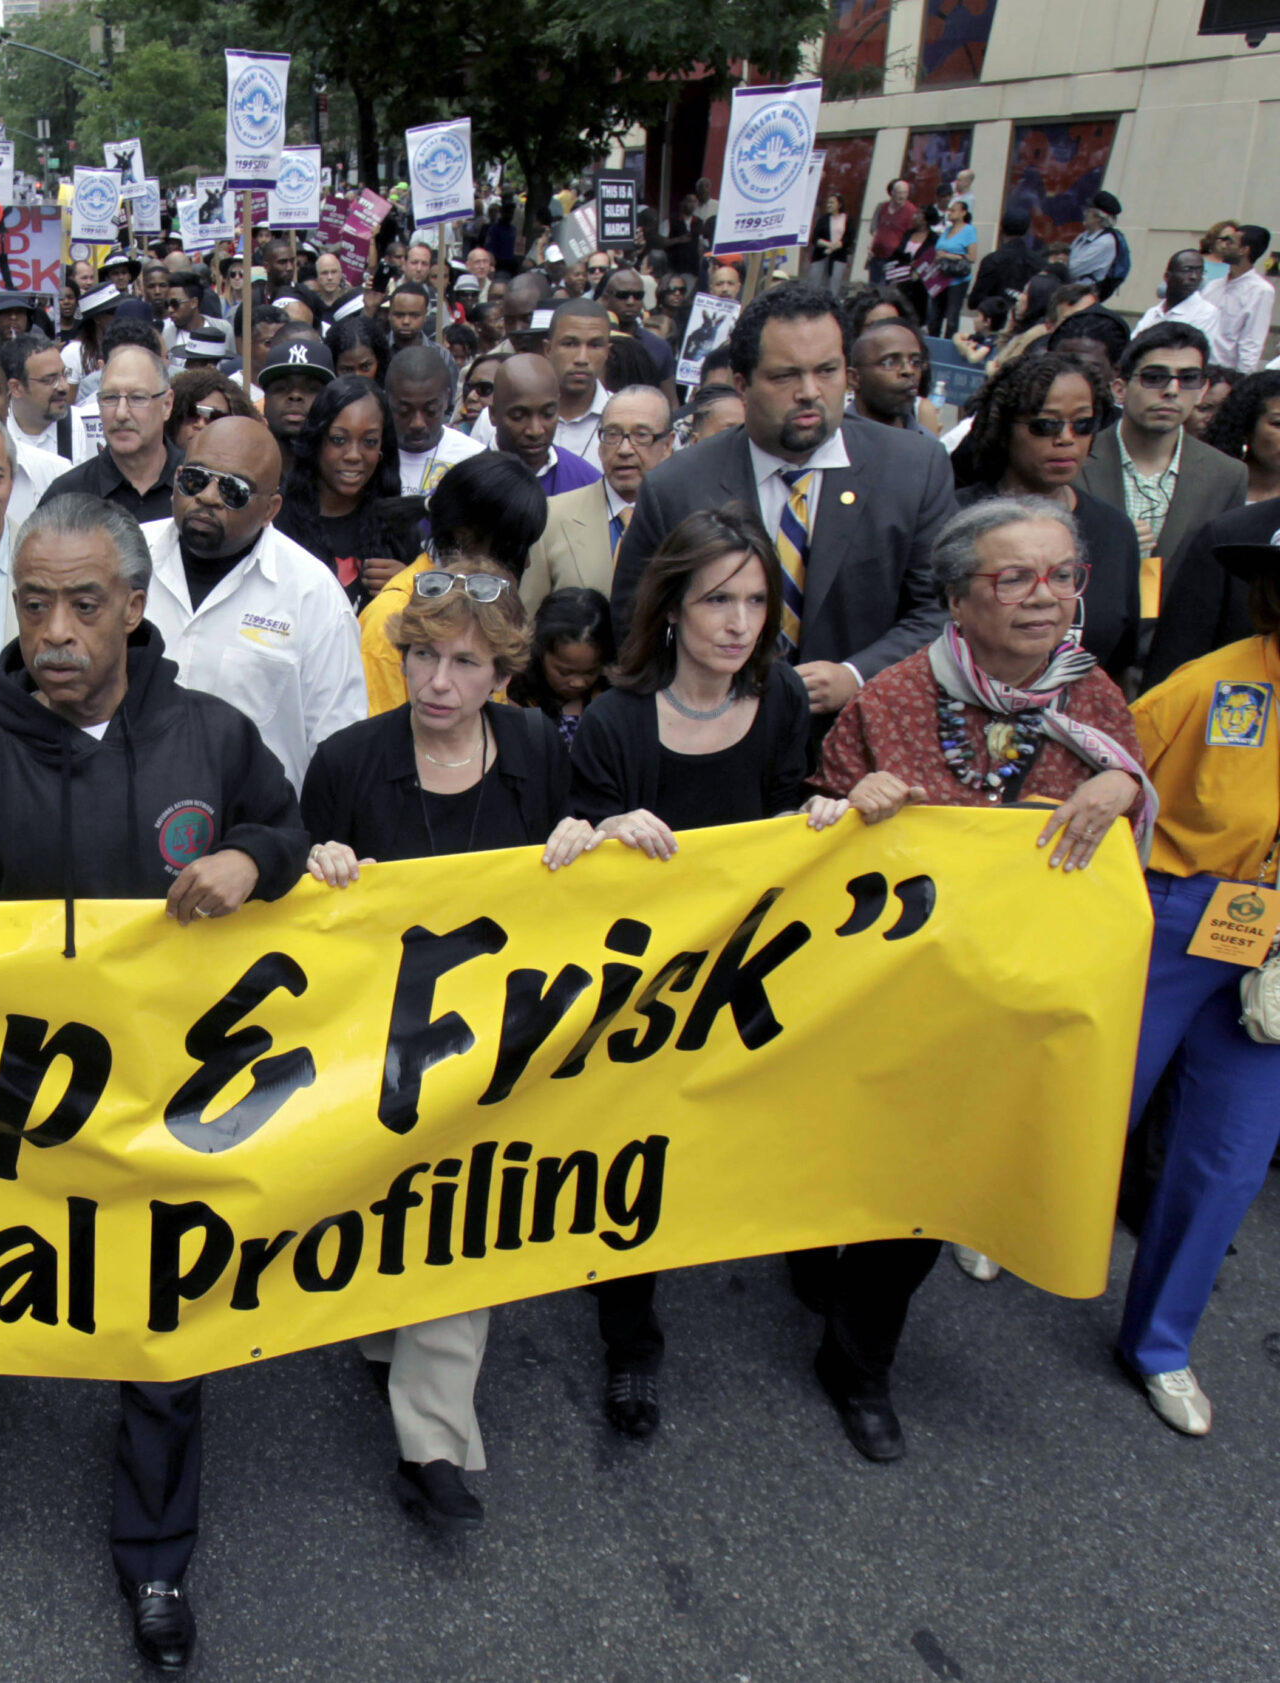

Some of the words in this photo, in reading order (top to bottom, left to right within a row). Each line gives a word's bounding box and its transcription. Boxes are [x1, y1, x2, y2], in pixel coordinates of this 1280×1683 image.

[744, 111, 777, 140] SILENT
[781, 109, 806, 137] MARCH
[601, 185, 617, 199] THIS
[618, 185, 626, 199] IS
[627, 185, 633, 199] A
[604, 204, 630, 217] SILENT
[604, 223, 630, 237] MARCH
[734, 213, 785, 230] 1199SEIU
[288, 343, 308, 364] NY
[244, 613, 291, 631] 1199SEIU
[1210, 918, 1265, 936] SPECIAL
[1210, 932, 1255, 947] GUEST
[164, 951, 317, 1153] &
[148, 1135, 669, 1332] Profiling
